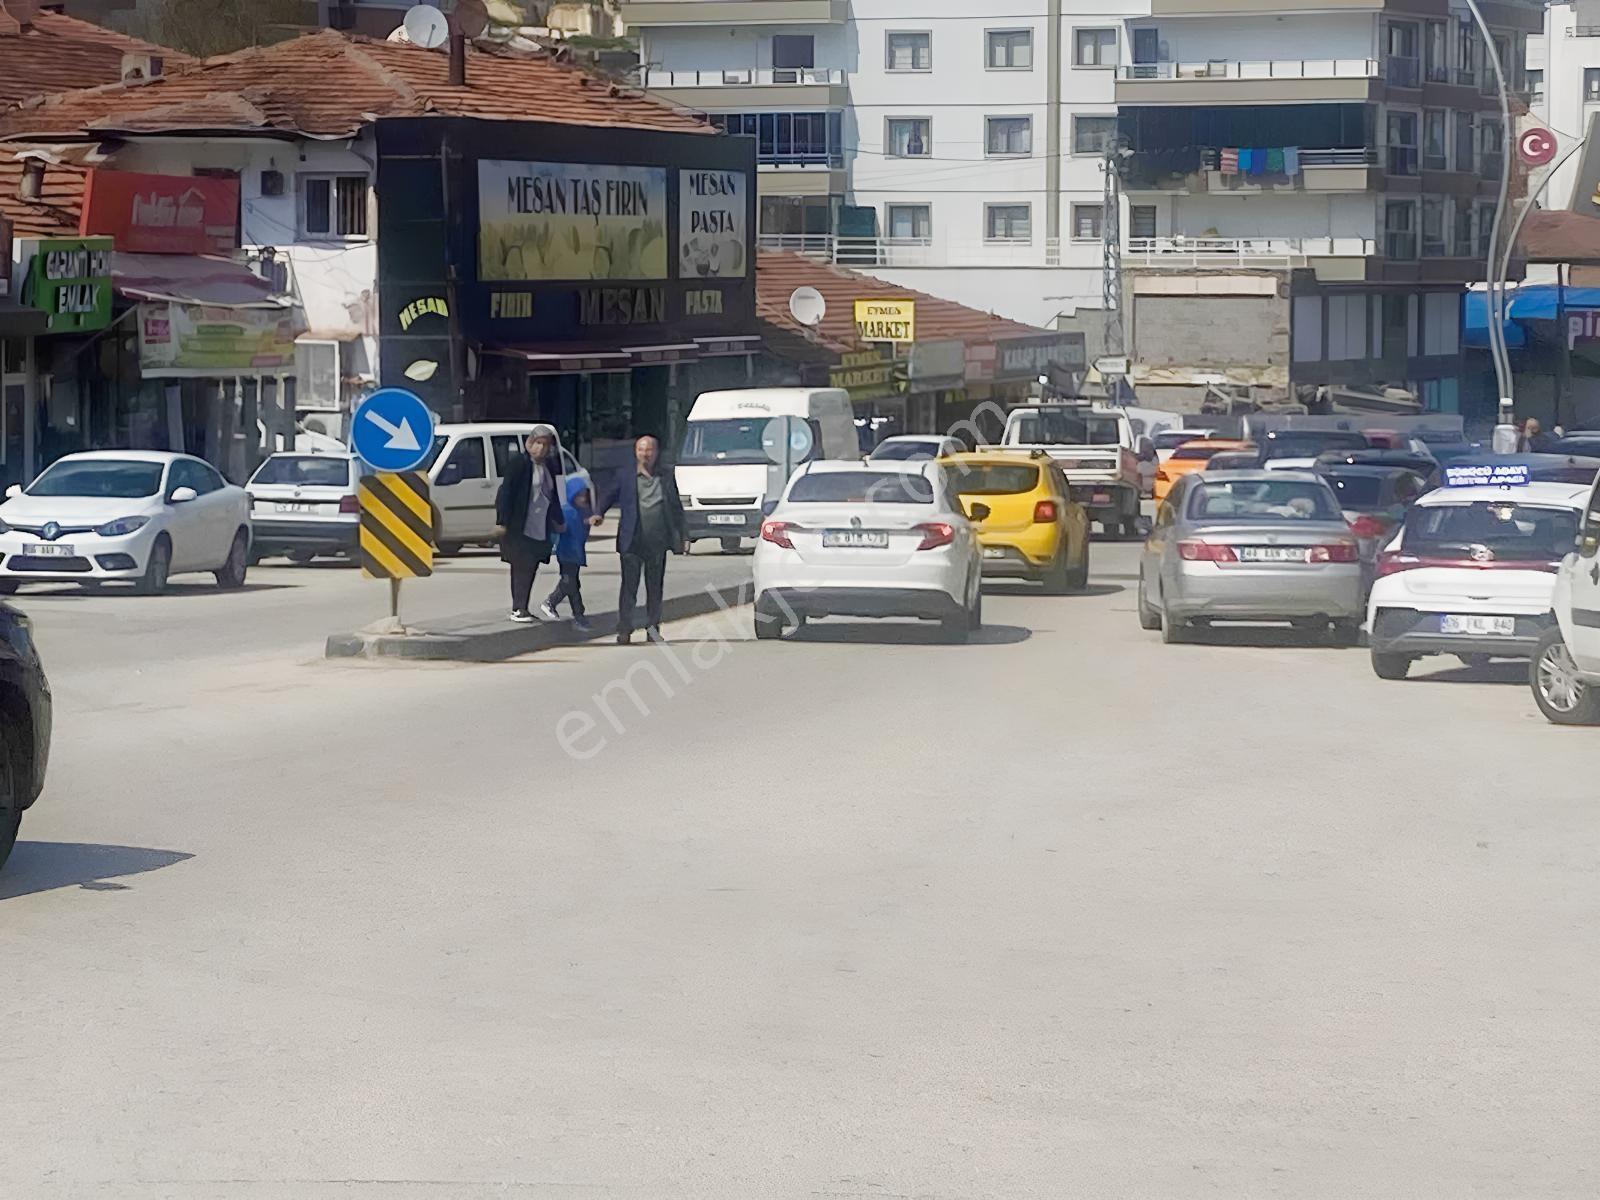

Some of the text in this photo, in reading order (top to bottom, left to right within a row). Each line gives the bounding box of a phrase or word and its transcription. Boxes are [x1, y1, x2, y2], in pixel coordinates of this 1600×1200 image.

[689, 172, 736, 197] MESAN
[507, 175, 648, 225] MESAN TAŞ FIRIN
[691, 209, 735, 234] PASTA
[58, 285, 101, 313] EMLAK
[578, 287, 665, 325] MESAN
[685, 290, 723, 315] PASTA
[398, 296, 450, 331] MESAN
[855, 320, 911, 340] MARKET
[829, 369, 892, 388] MARKET
